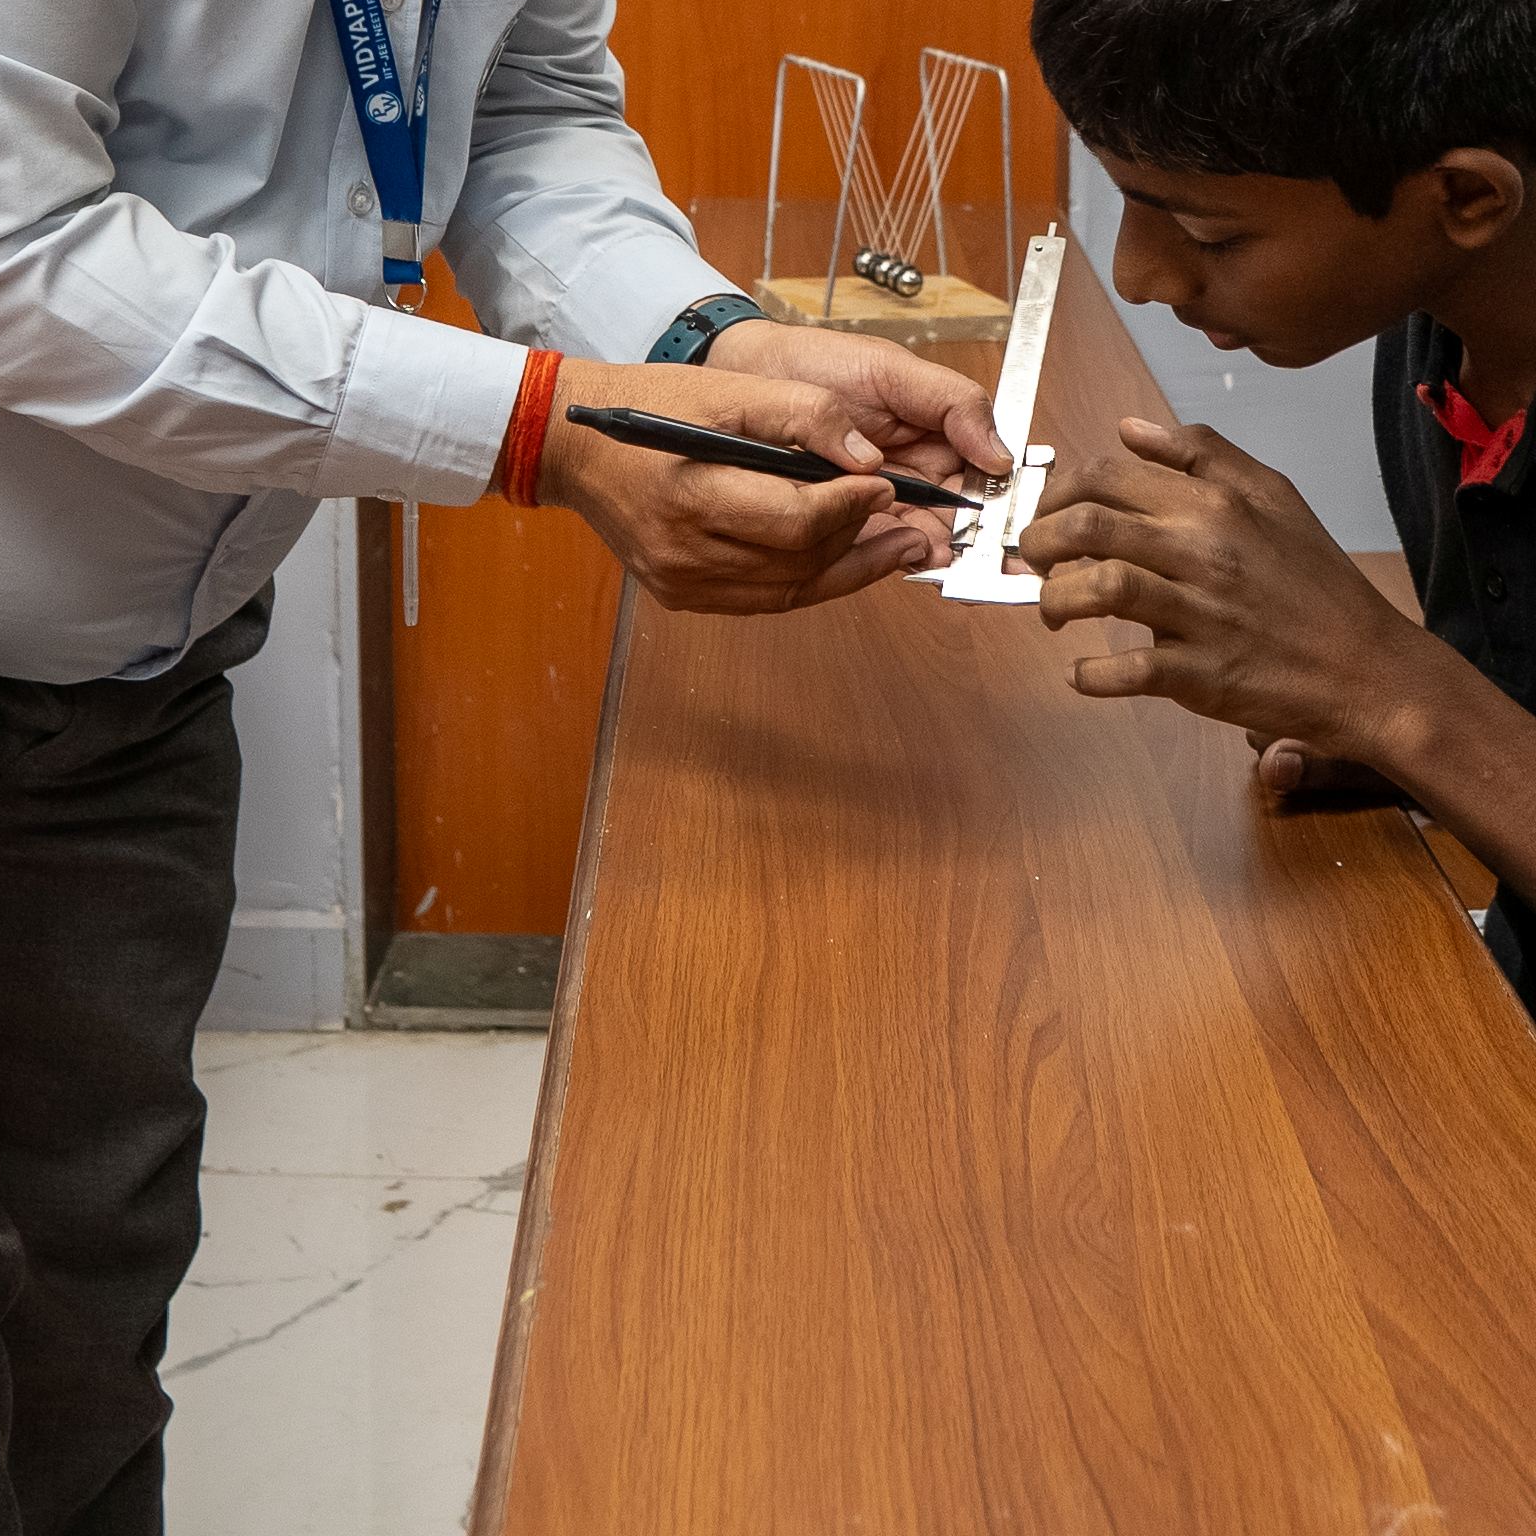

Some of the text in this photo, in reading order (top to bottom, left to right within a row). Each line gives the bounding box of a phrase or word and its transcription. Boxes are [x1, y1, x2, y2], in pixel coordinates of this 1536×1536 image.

[371, 14, 384, 38] NEET
[379, 42, 393, 79] IIT-JEE
[369, 94, 398, 121] PW
